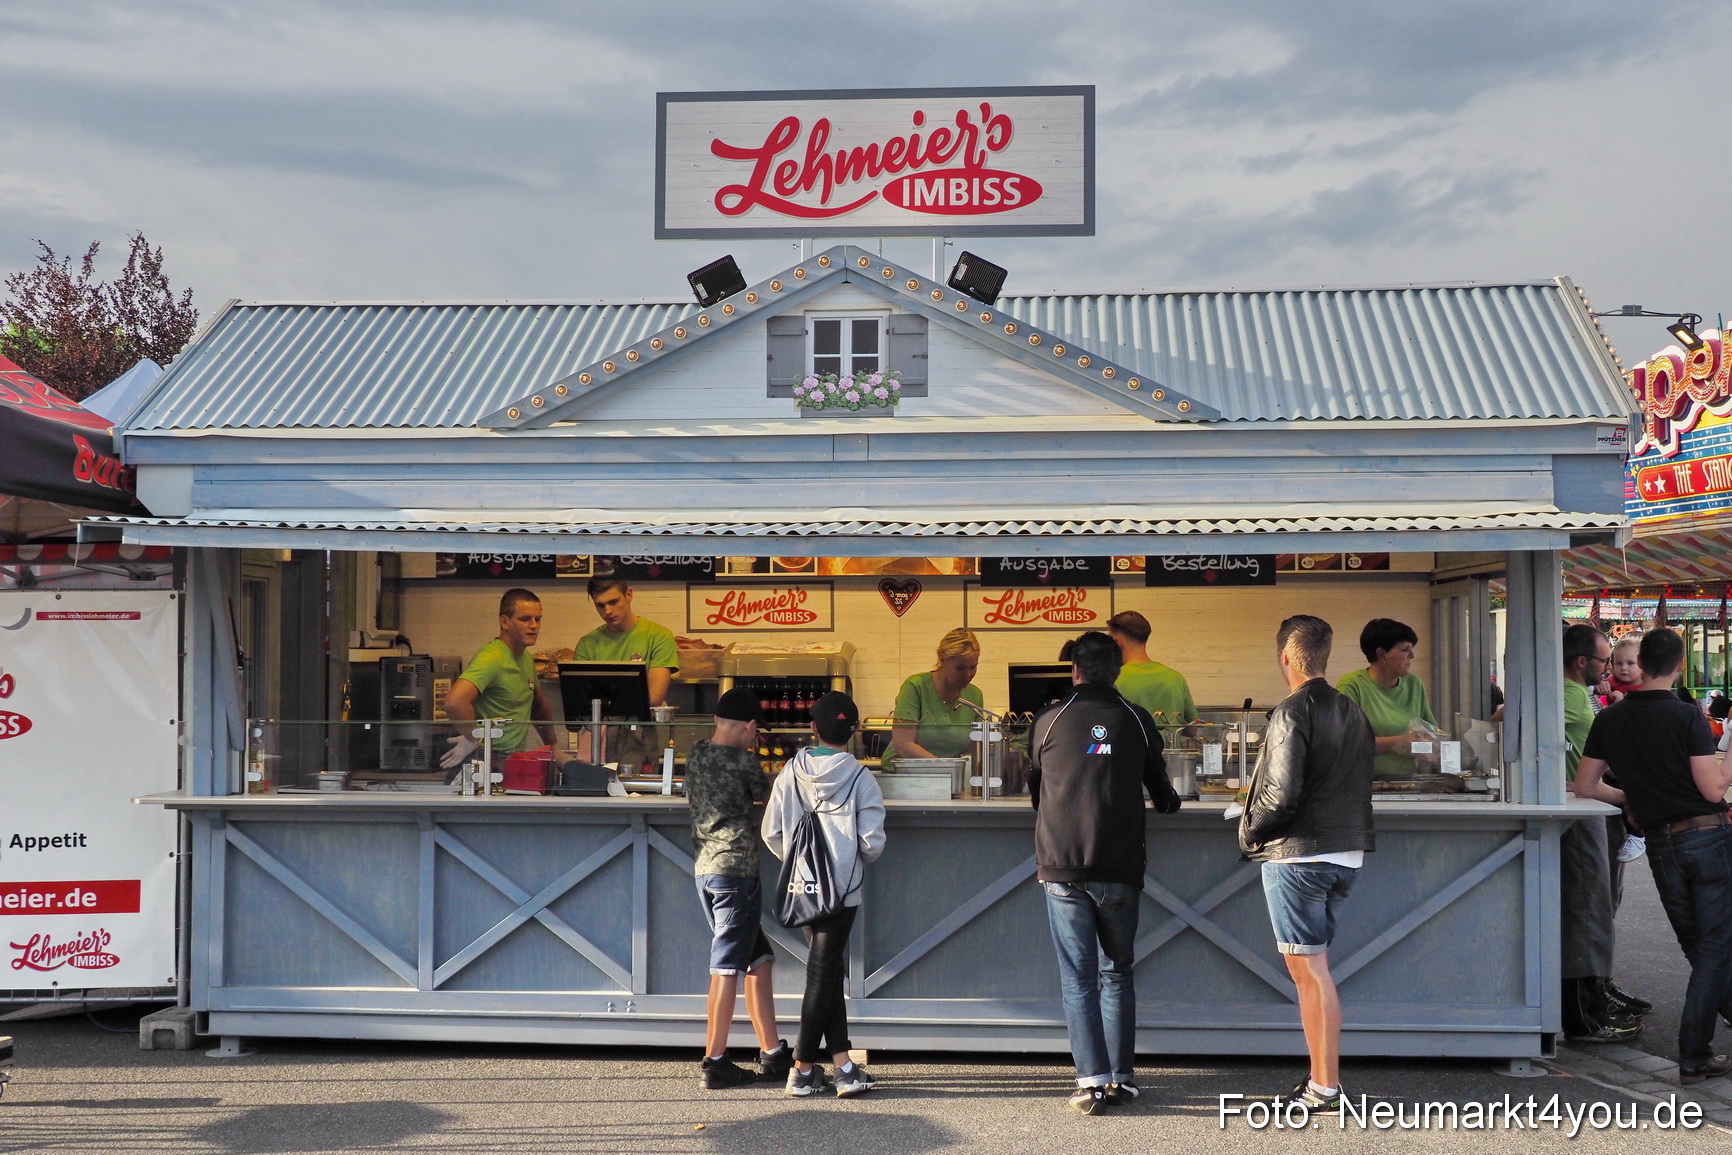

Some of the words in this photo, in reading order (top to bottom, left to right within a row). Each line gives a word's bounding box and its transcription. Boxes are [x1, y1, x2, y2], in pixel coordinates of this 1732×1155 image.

[711, 102, 1013, 218] Lehmeier's
[902, 176, 1021, 207] IMBISS
[1672, 463, 1695, 495] THE
[1000, 556, 1090, 578] Ausgabe
[1162, 554, 1260, 577] Bestellung
[47, 612, 130, 620] www.imbisslehmeier.de
[705, 586, 808, 626] Lehmeier's
[769, 611, 811, 623] IMBISS
[983, 587, 1087, 625] Lehmeier's
[1048, 611, 1091, 622] IMBISS
[9, 832, 87, 852] Appetit
[0, 887, 97, 909] eier.de
[9, 928, 111, 972] Lehmeier's
[73, 954, 114, 967] IMBISS
